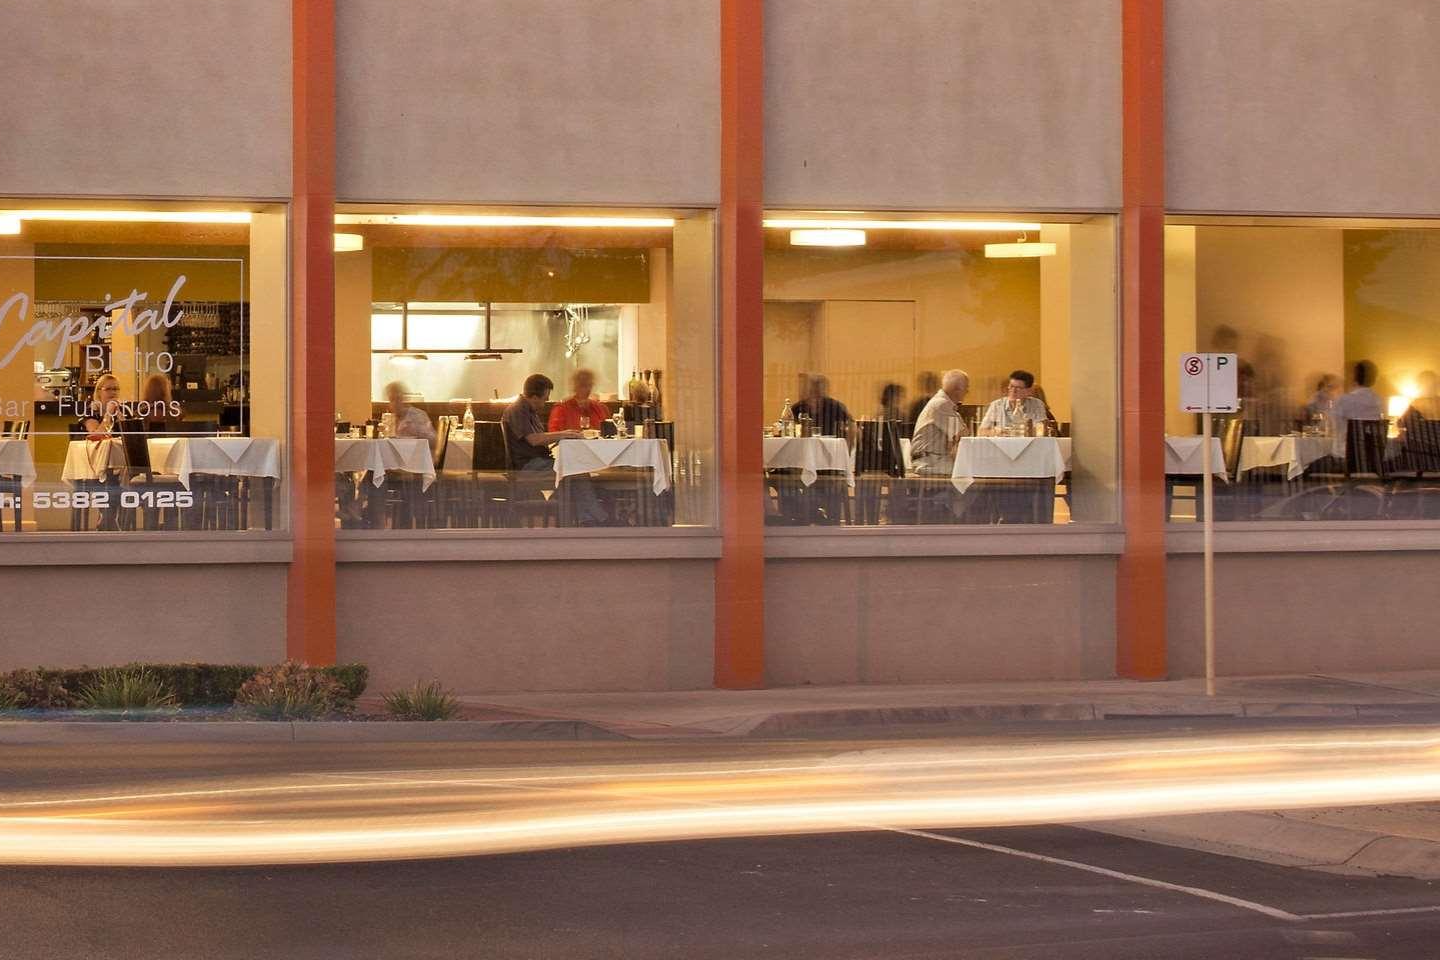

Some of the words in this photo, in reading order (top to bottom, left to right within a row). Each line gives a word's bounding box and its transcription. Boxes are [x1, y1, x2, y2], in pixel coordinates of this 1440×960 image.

[84, 344, 174, 374] Bistro
[1216, 356, 1229, 371] P
[32, 491, 110, 509] 5382
[120, 491, 194, 509] 0125
